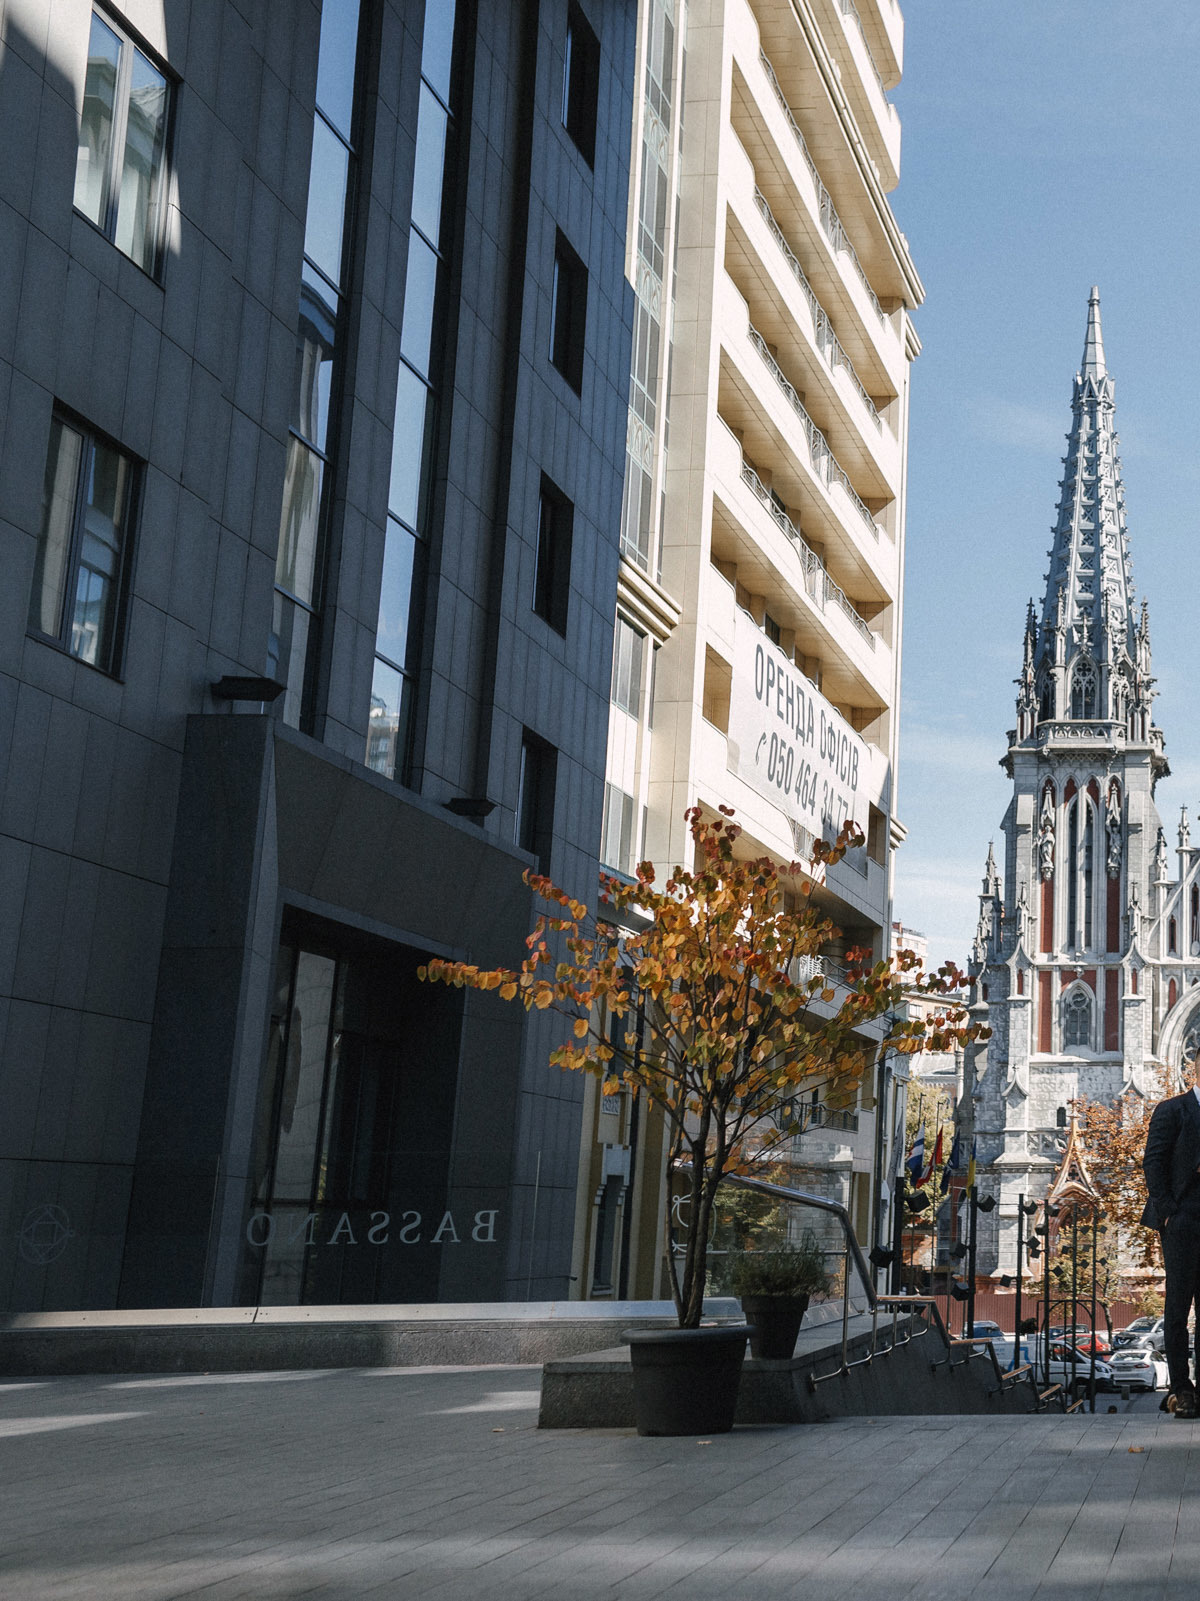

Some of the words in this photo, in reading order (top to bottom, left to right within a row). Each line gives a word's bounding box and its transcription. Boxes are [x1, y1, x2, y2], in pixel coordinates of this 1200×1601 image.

[755, 643, 814, 749] ОРЕНДА
[820, 709, 859, 792] ОФІСІВ
[767, 731, 794, 796] 050
[794, 759, 818, 817] 464
[820, 779, 834, 831] 34
